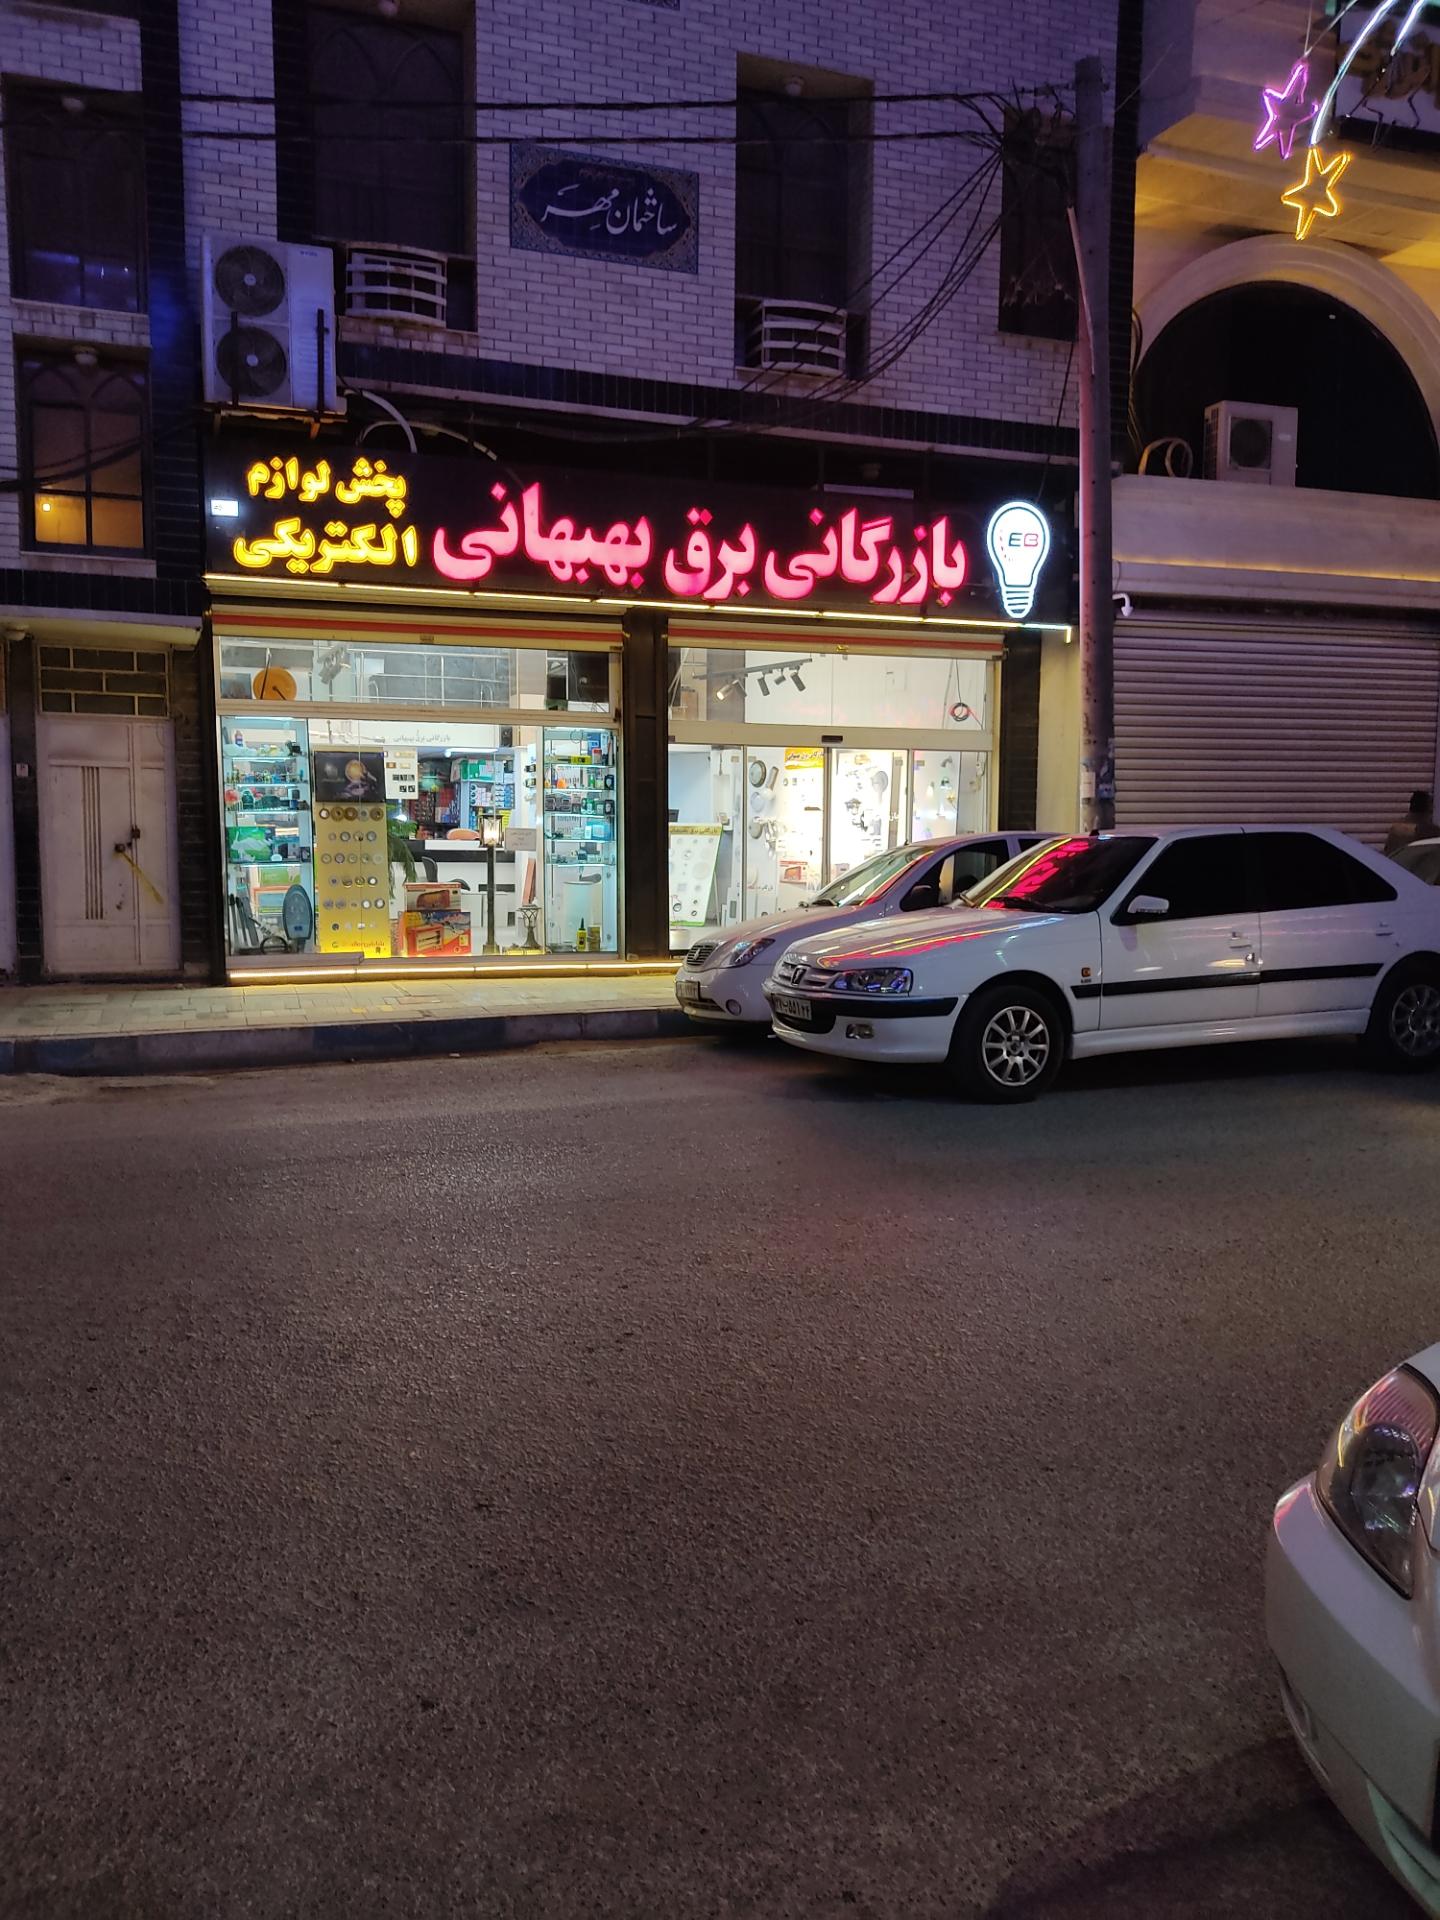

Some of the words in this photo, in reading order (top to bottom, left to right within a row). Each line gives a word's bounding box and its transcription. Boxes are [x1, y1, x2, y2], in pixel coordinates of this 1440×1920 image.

[247, 456, 331, 502] لوازم
[335, 457, 408, 519] پخش
[233, 517, 419, 574] الکتریکی
[432, 482, 653, 589] بهبهانی
[664, 506, 758, 601] برق
[764, 507, 968, 607] بازرگانی
